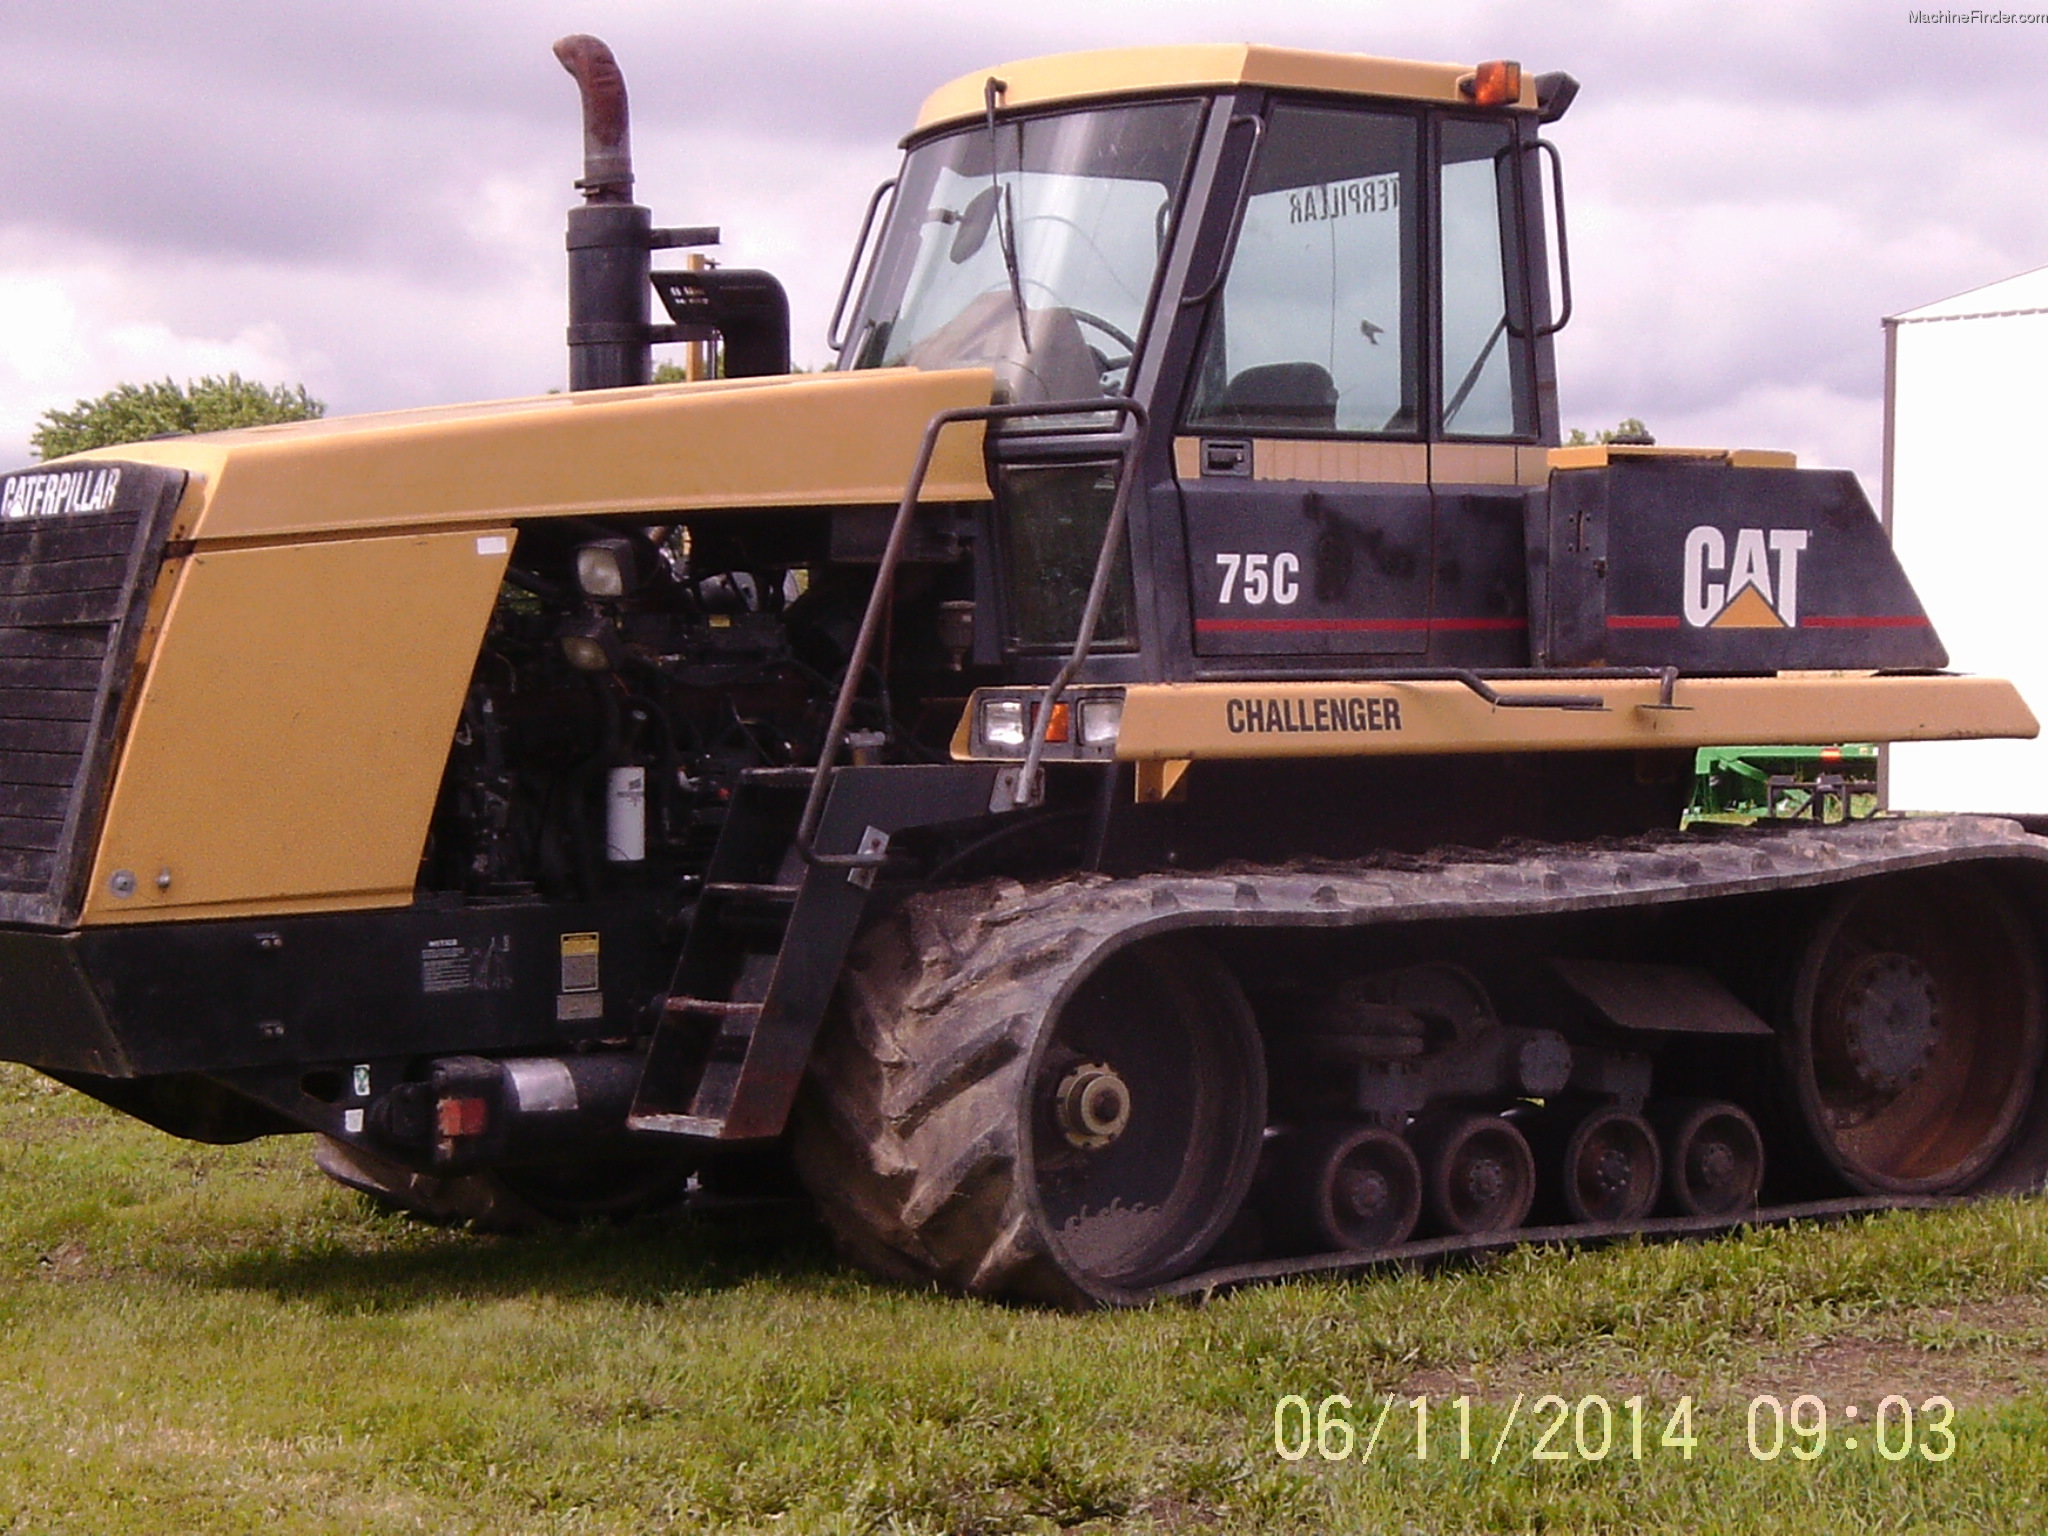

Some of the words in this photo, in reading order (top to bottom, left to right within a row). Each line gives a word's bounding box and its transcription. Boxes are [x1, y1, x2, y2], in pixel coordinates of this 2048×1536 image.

[1, 468, 121, 517] CATERPILLAR
[1216, 552, 1299, 604] 75C
[1684, 525, 1807, 628] CAT
[1226, 697, 1402, 734] CHALLENGER
